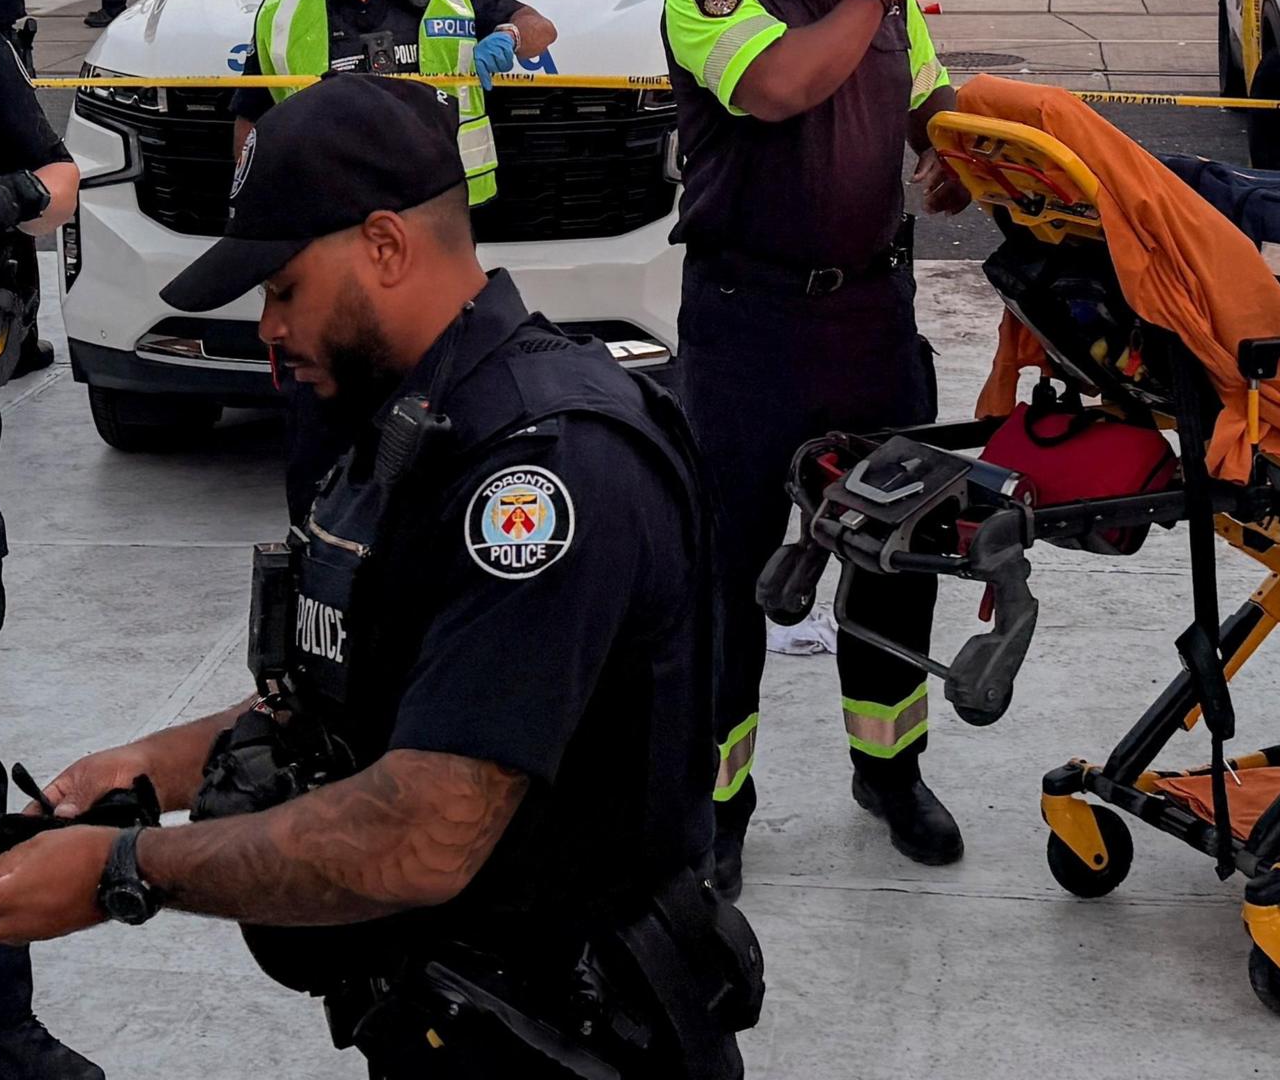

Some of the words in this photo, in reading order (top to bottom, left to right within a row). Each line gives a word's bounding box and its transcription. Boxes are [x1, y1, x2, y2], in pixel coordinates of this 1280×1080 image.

[434, 19, 476, 35] POLIC
[482, 473, 556, 500] TORONTO
[490, 543, 547, 569] POLICE
[295, 594, 348, 664] POLICE
